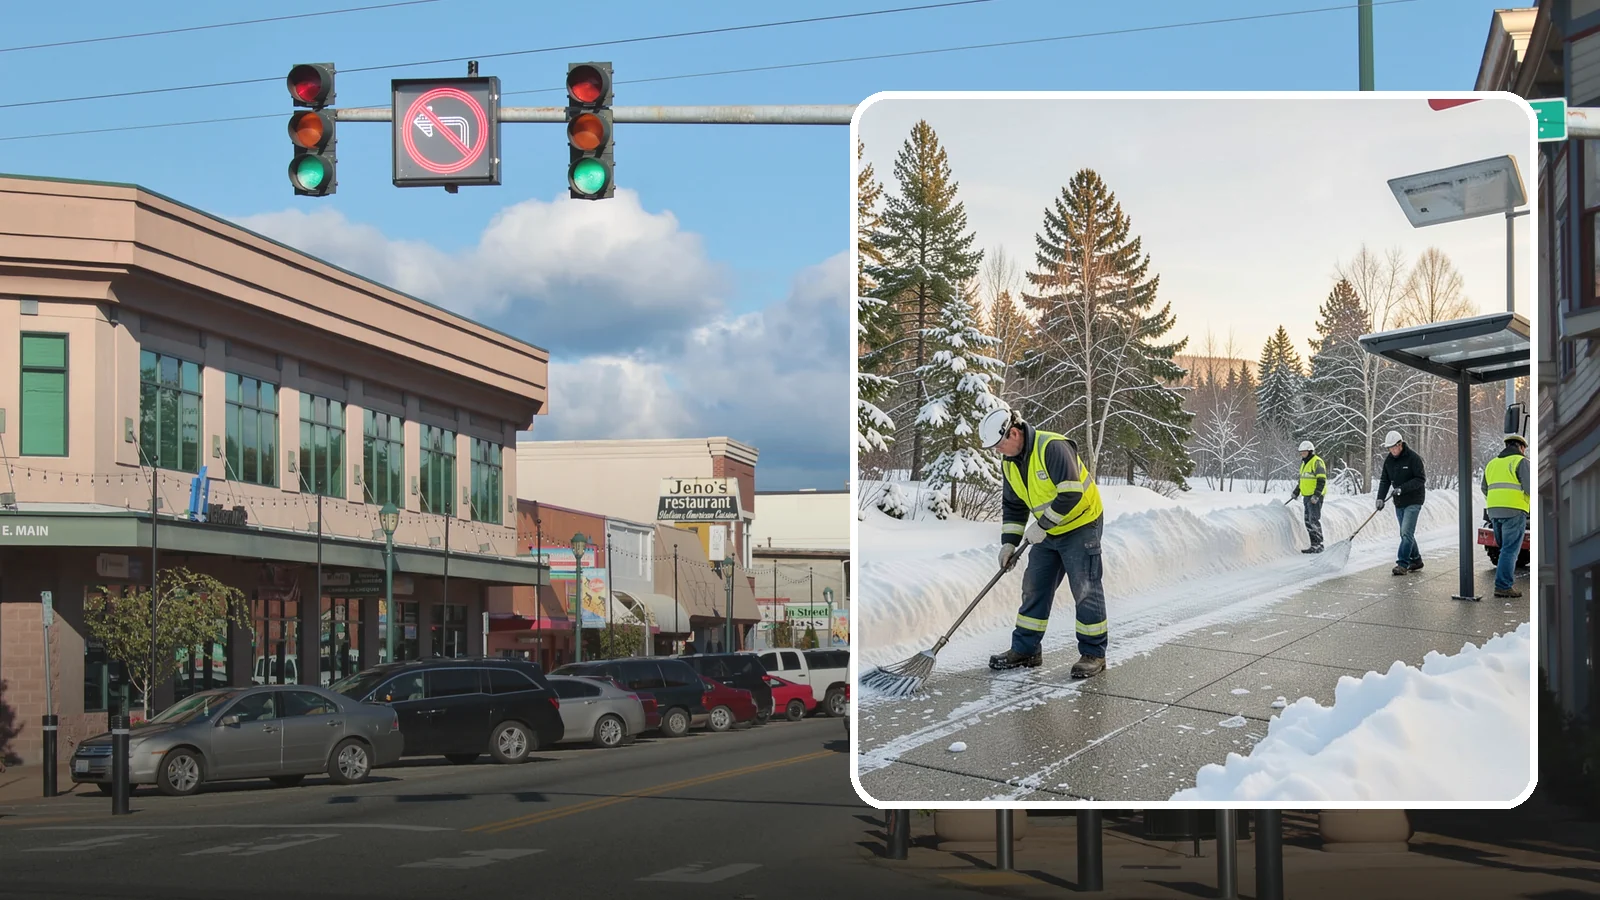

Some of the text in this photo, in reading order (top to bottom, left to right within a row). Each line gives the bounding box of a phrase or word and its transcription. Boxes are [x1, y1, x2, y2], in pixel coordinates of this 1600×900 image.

[669, 480, 727, 494] Jeno's
[665, 496, 731, 509] restaurant
[658, 509, 681, 519] Italian
[686, 509, 714, 519] American
[715, 509, 738, 519] Cuisine
[2, 525, 49, 536] E. MAIN
[797, 608, 828, 616] Street
